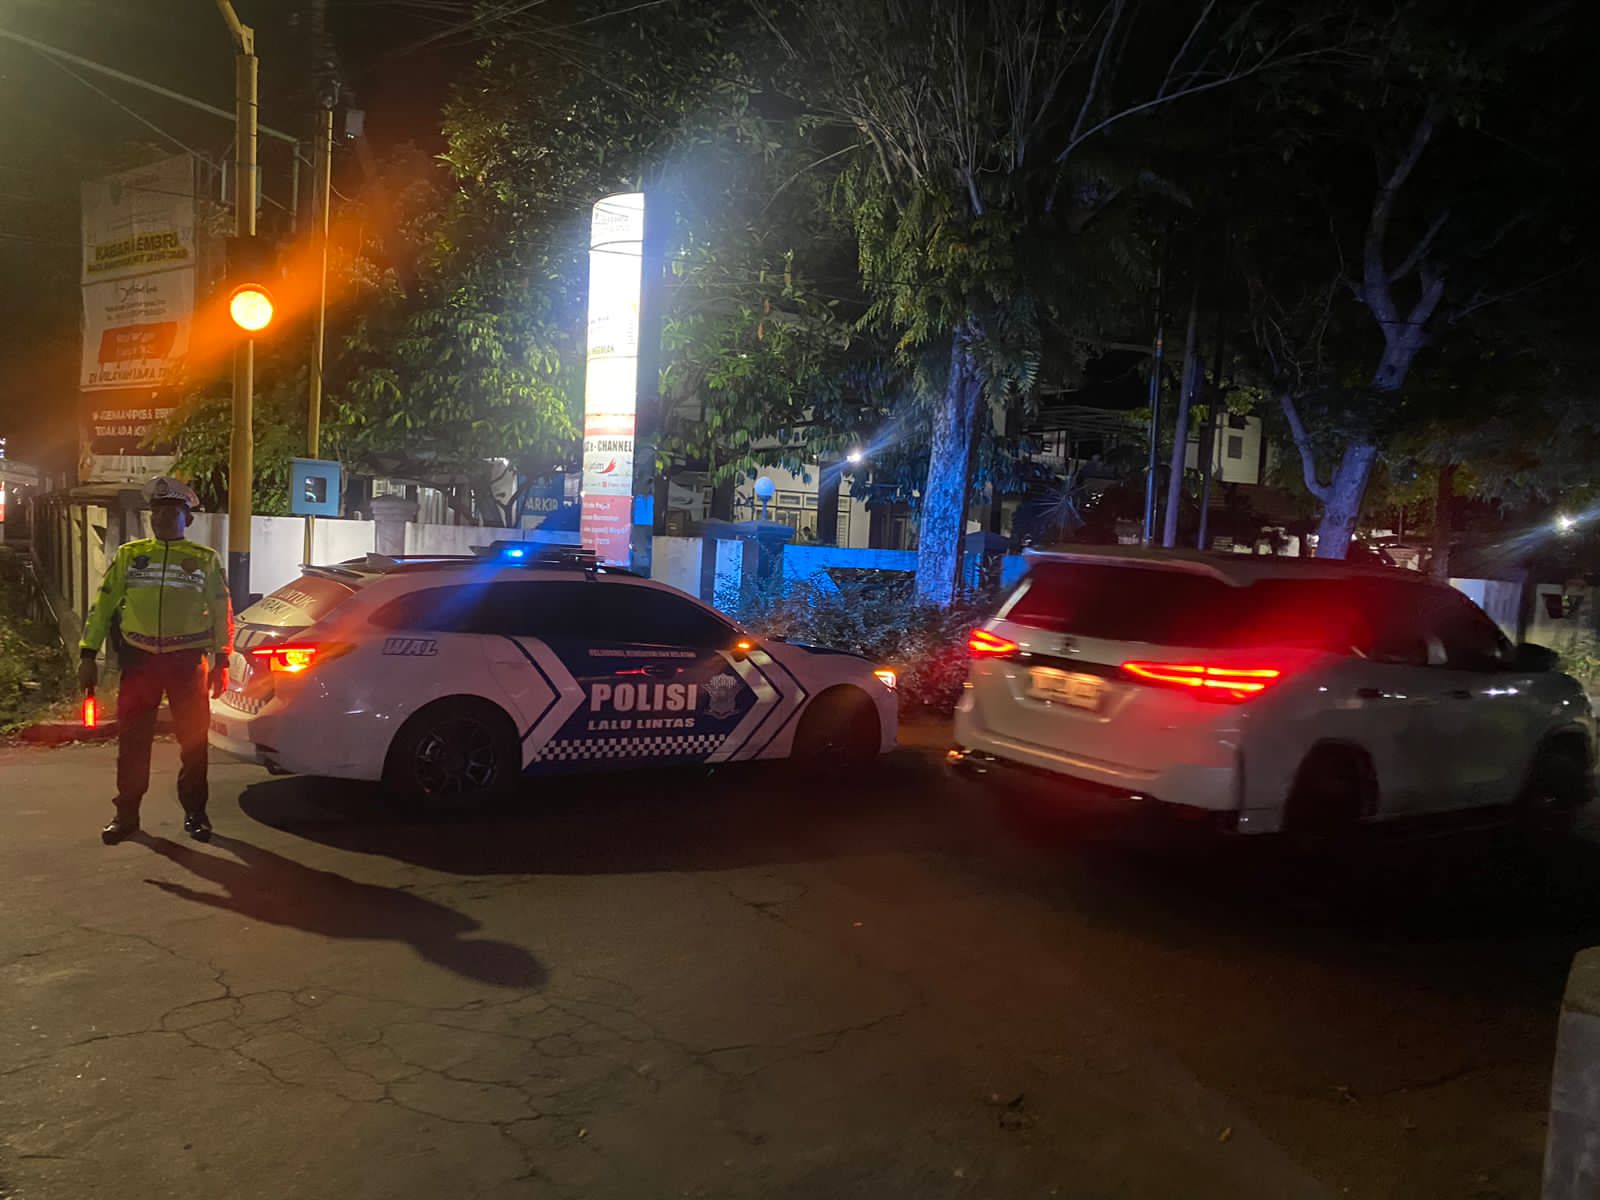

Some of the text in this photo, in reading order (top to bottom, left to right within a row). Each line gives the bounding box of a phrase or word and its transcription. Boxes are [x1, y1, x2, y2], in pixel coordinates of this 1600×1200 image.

[590, 683, 697, 712] POLISI
[588, 718, 695, 731] LALU LINTAS
